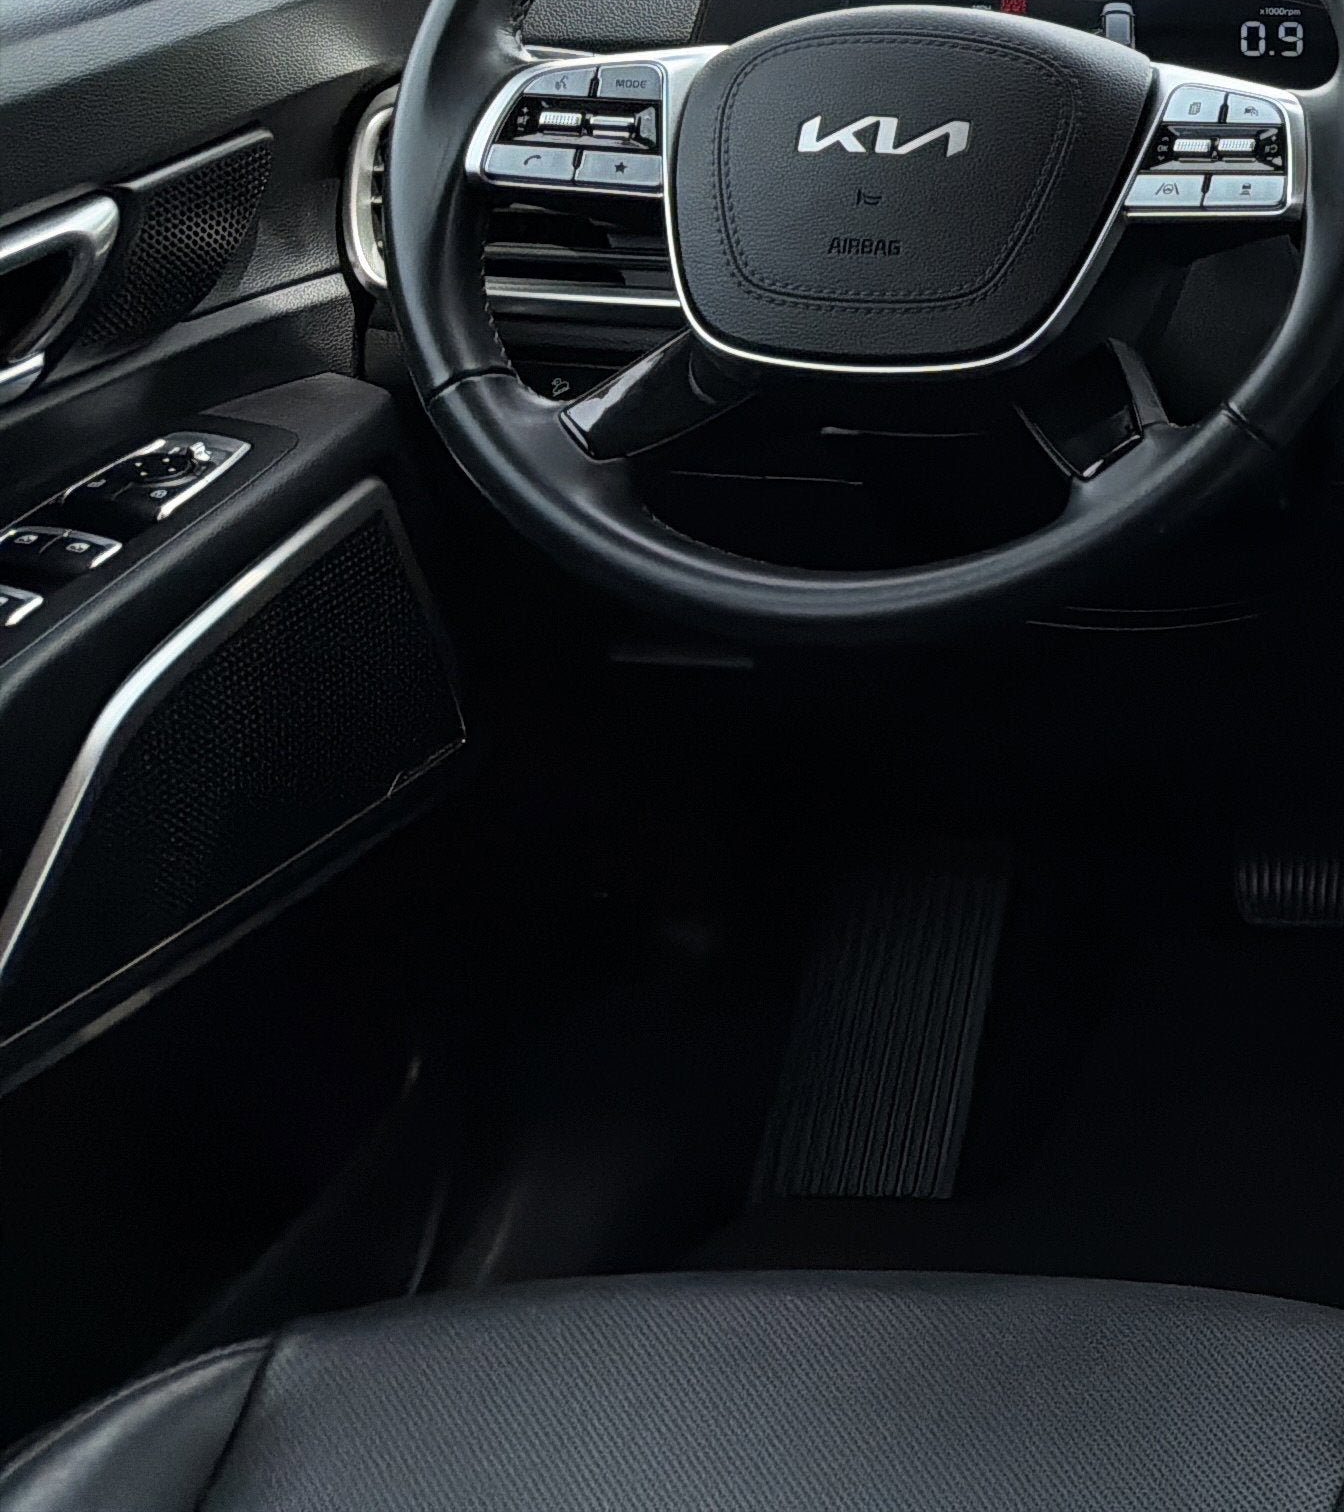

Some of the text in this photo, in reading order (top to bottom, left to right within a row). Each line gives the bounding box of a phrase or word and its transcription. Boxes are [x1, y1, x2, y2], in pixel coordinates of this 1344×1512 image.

[1240, 20, 1304, 57] 0.9
[616, 78, 647, 89] MODE
[798, 115, 971, 157] KIA
[827, 236, 902, 257] AIRBAG
